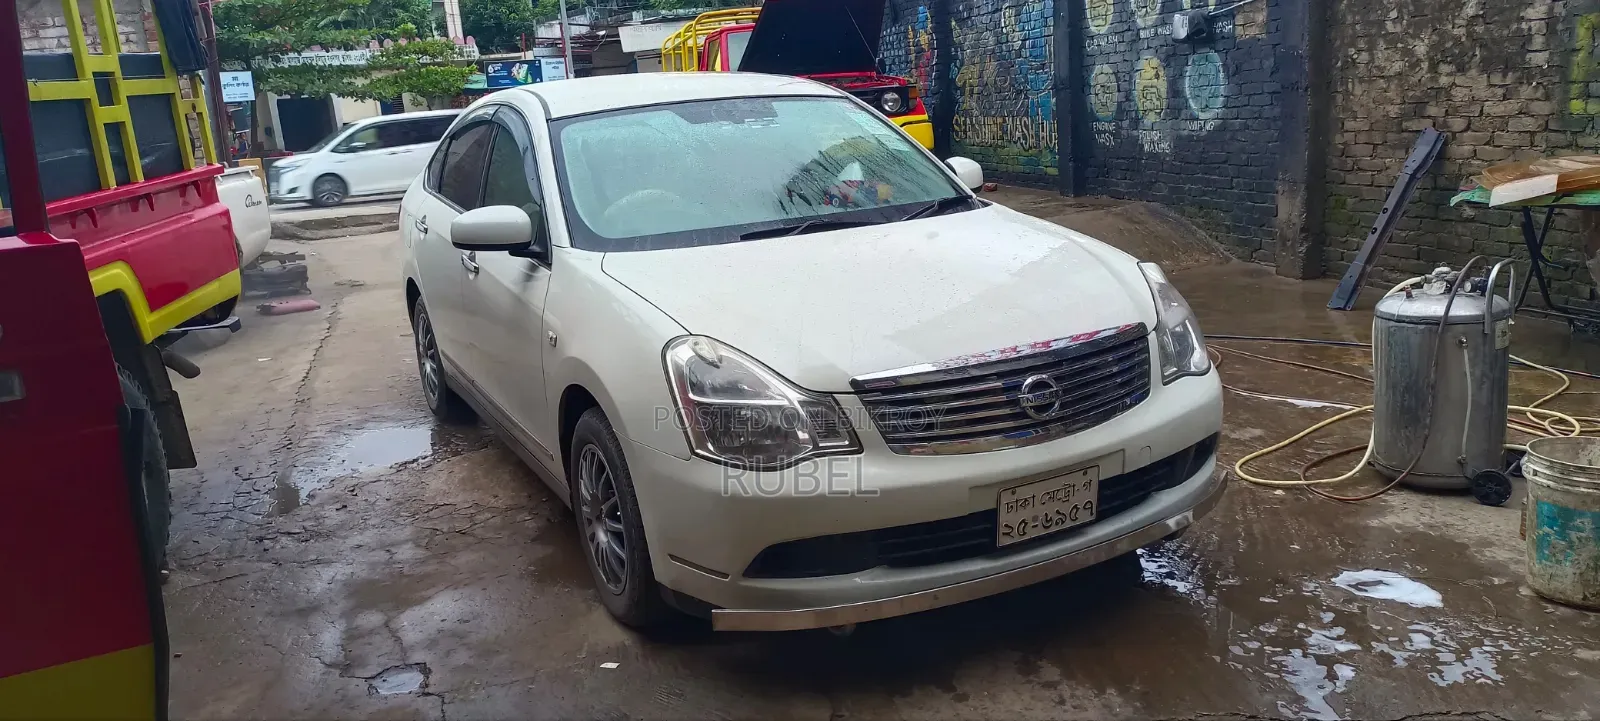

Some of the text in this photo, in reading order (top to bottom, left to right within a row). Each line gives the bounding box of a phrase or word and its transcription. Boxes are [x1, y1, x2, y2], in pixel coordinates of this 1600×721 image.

[1140, 28, 1155, 39] BIKE
[1005, 115, 1036, 151] WASH
[1093, 121, 1116, 132] ENGINE
[1138, 130, 1163, 141] POLISH
[1026, 390, 1059, 404] NISSAN
[1004, 494, 1036, 514] ঢাকা
[1001, 499, 1094, 539] ২৫-৬৯৫৭
